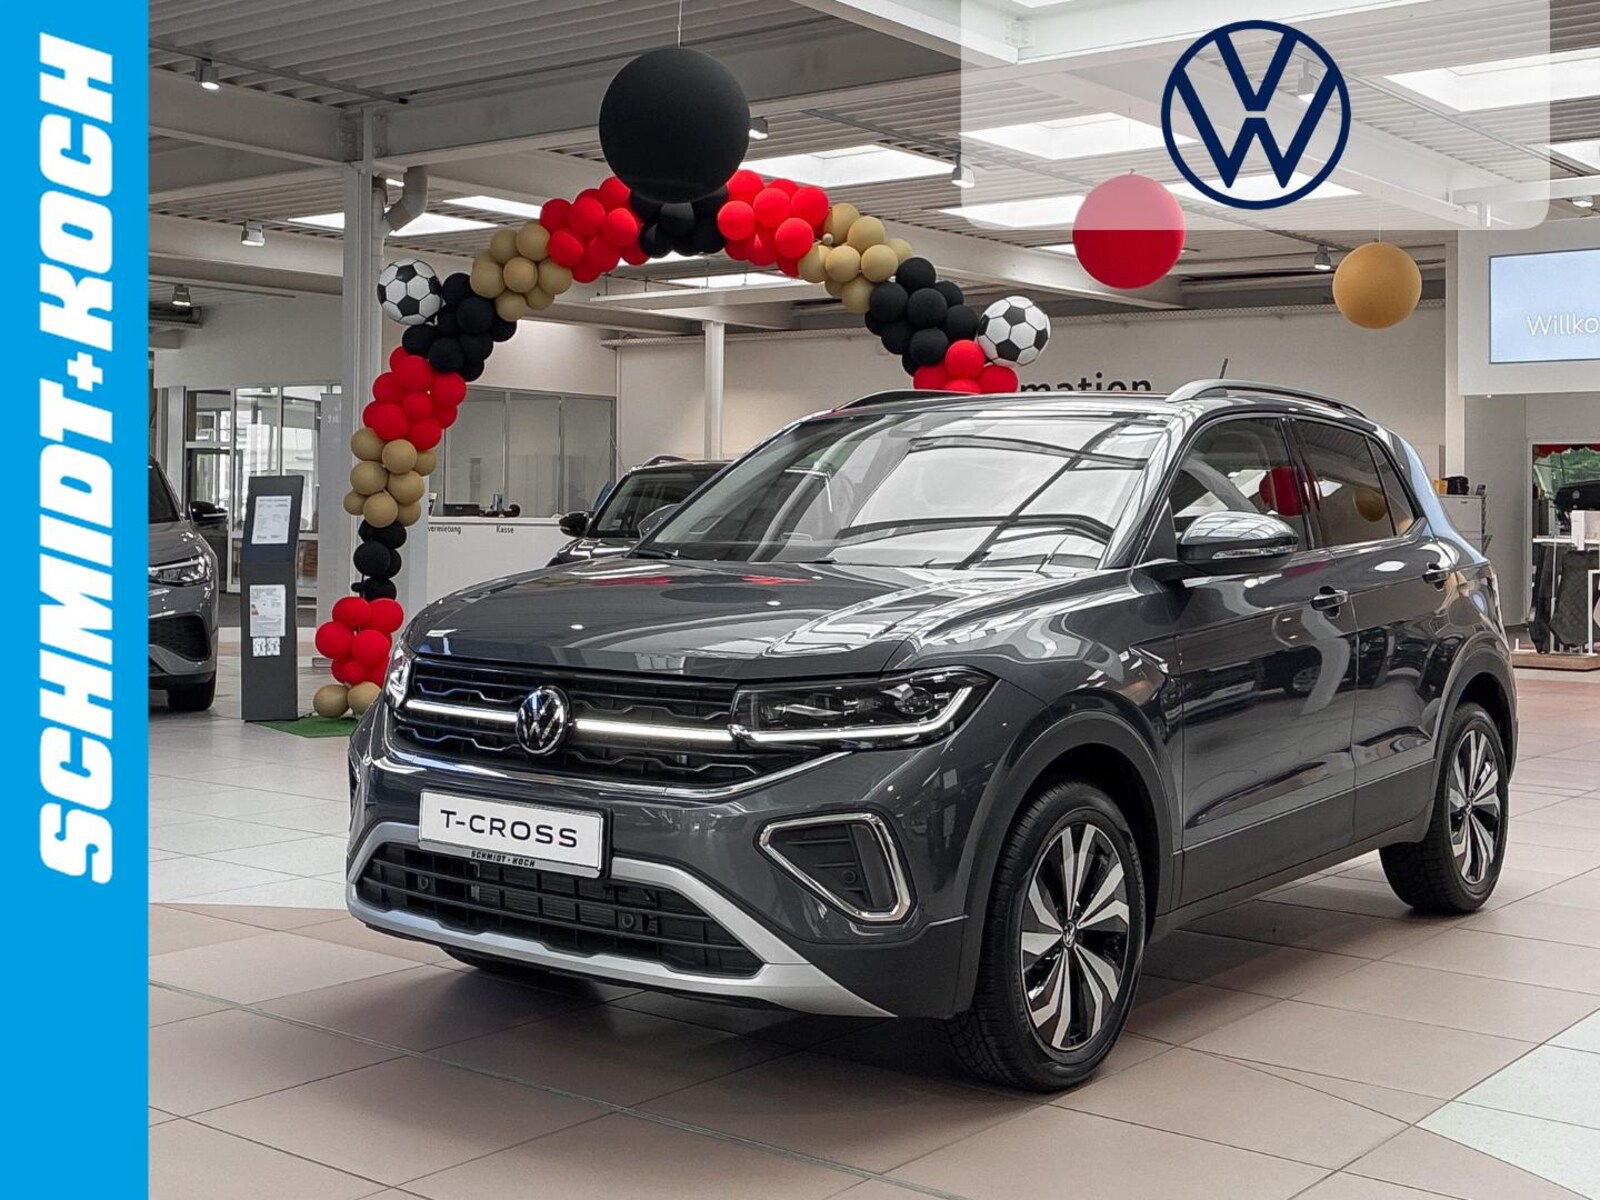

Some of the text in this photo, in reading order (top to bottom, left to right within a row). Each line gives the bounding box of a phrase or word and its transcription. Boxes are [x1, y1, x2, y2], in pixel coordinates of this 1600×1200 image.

[1526, 312, 1600, 336] Willko
[496, 524, 514, 534] Kasse
[440, 809, 578, 848] T-CROSS
